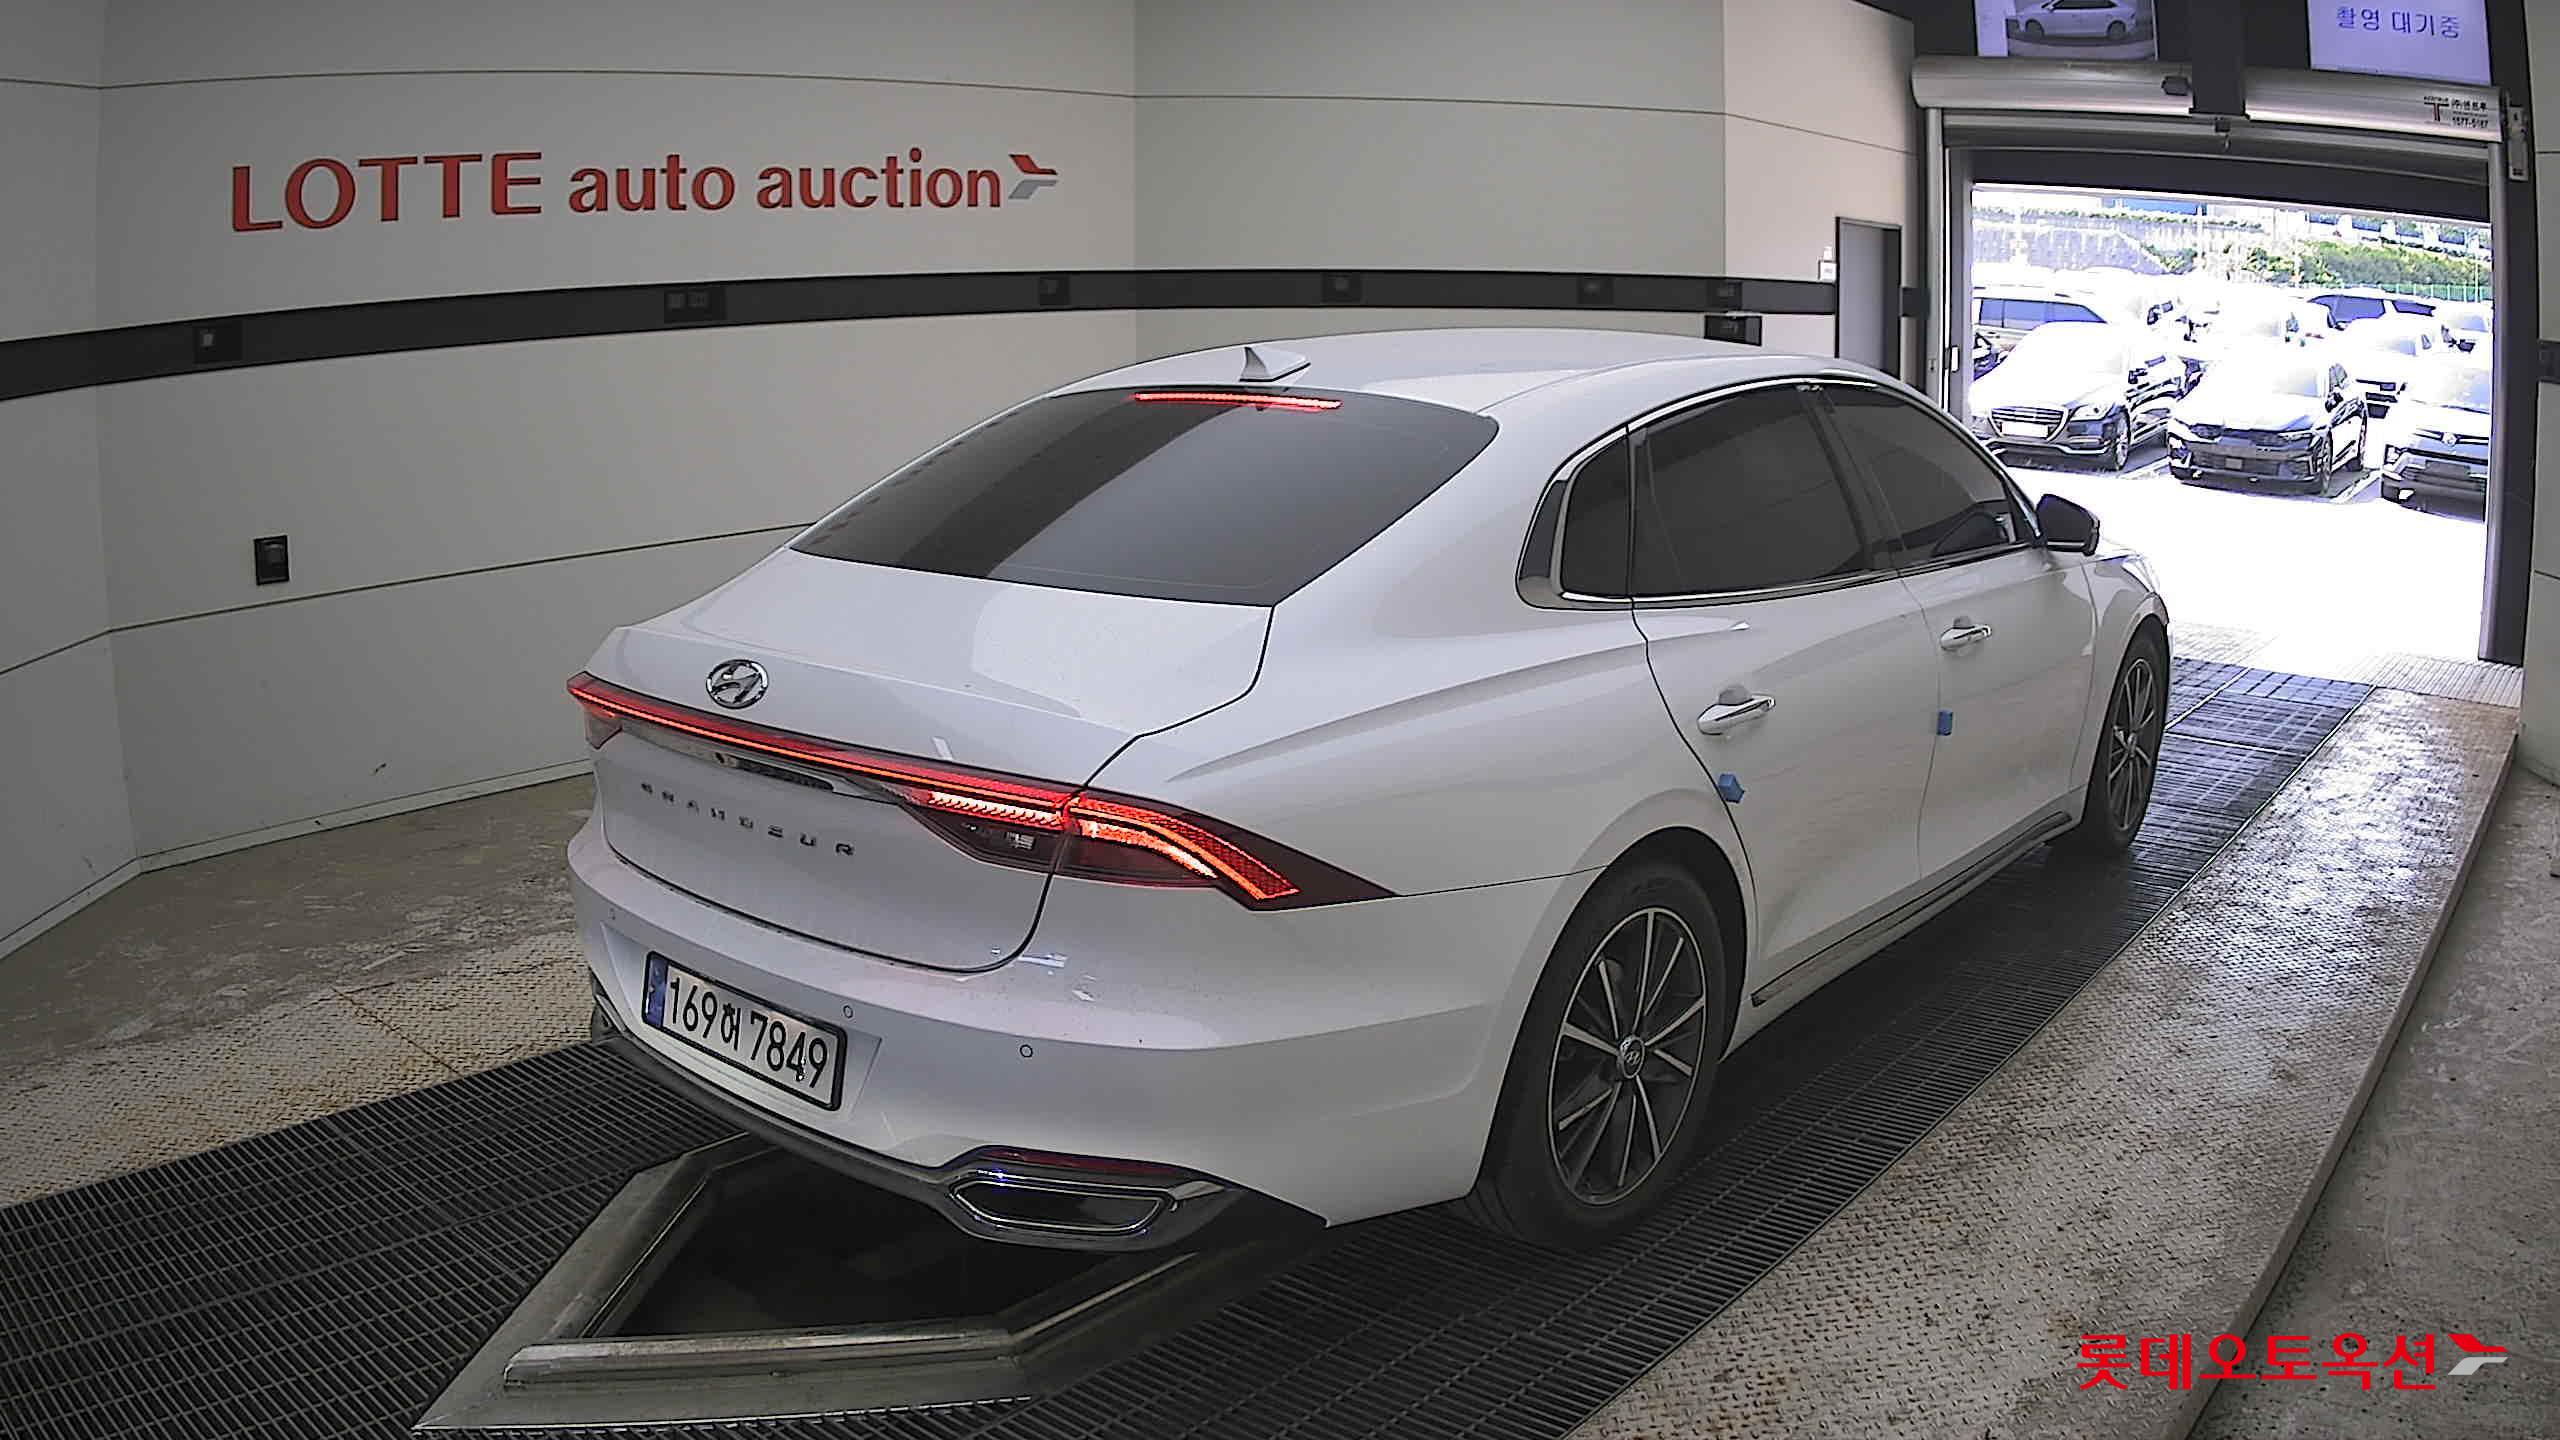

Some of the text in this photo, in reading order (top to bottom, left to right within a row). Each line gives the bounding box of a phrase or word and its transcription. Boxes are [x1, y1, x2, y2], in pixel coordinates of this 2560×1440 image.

[2337, 6, 2460, 39] 촬영 대기중
[232, 147, 1001, 232] LOTTE auto auction
[670, 977, 828, 1088] 169허 7849
